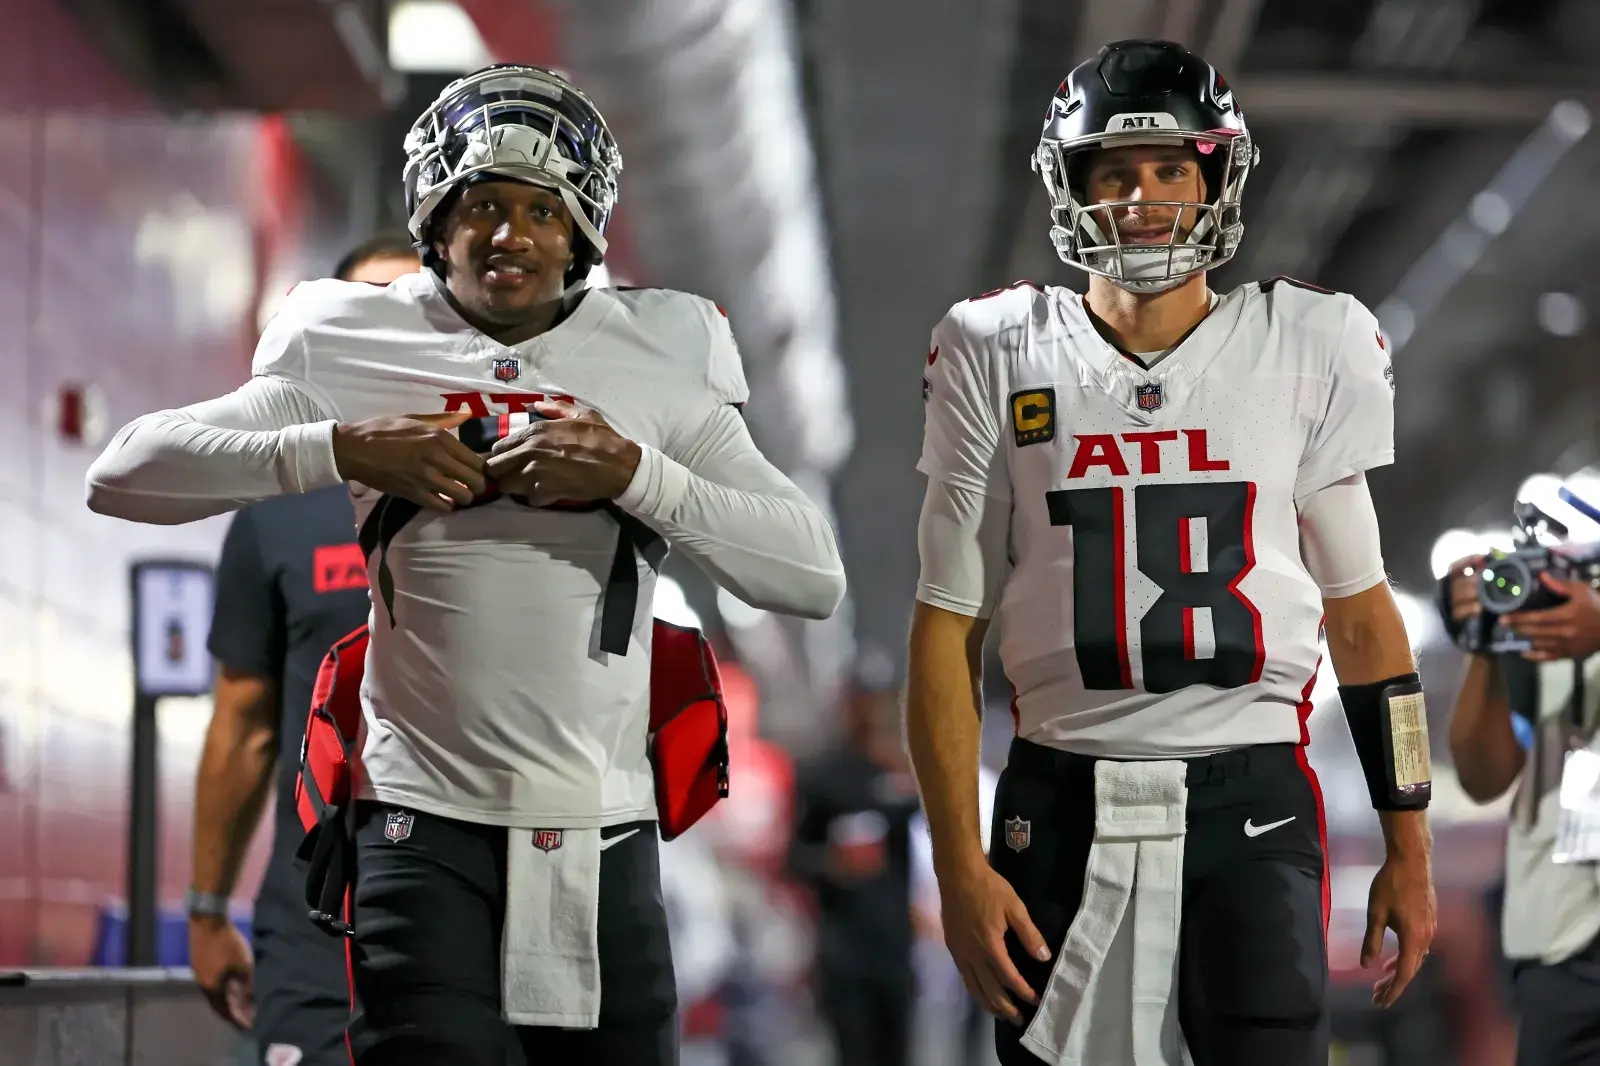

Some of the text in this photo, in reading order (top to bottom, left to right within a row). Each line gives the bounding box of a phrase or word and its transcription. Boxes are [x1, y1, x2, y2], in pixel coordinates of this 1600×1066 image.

[1121, 116, 1160, 129] ATL
[440, 391, 575, 418] AT
[1014, 393, 1050, 431] C
[1139, 394, 1161, 407] NFL
[1067, 428, 1231, 479] ATL
[1045, 481, 1266, 694] 18
[536, 831, 561, 849] NFL
